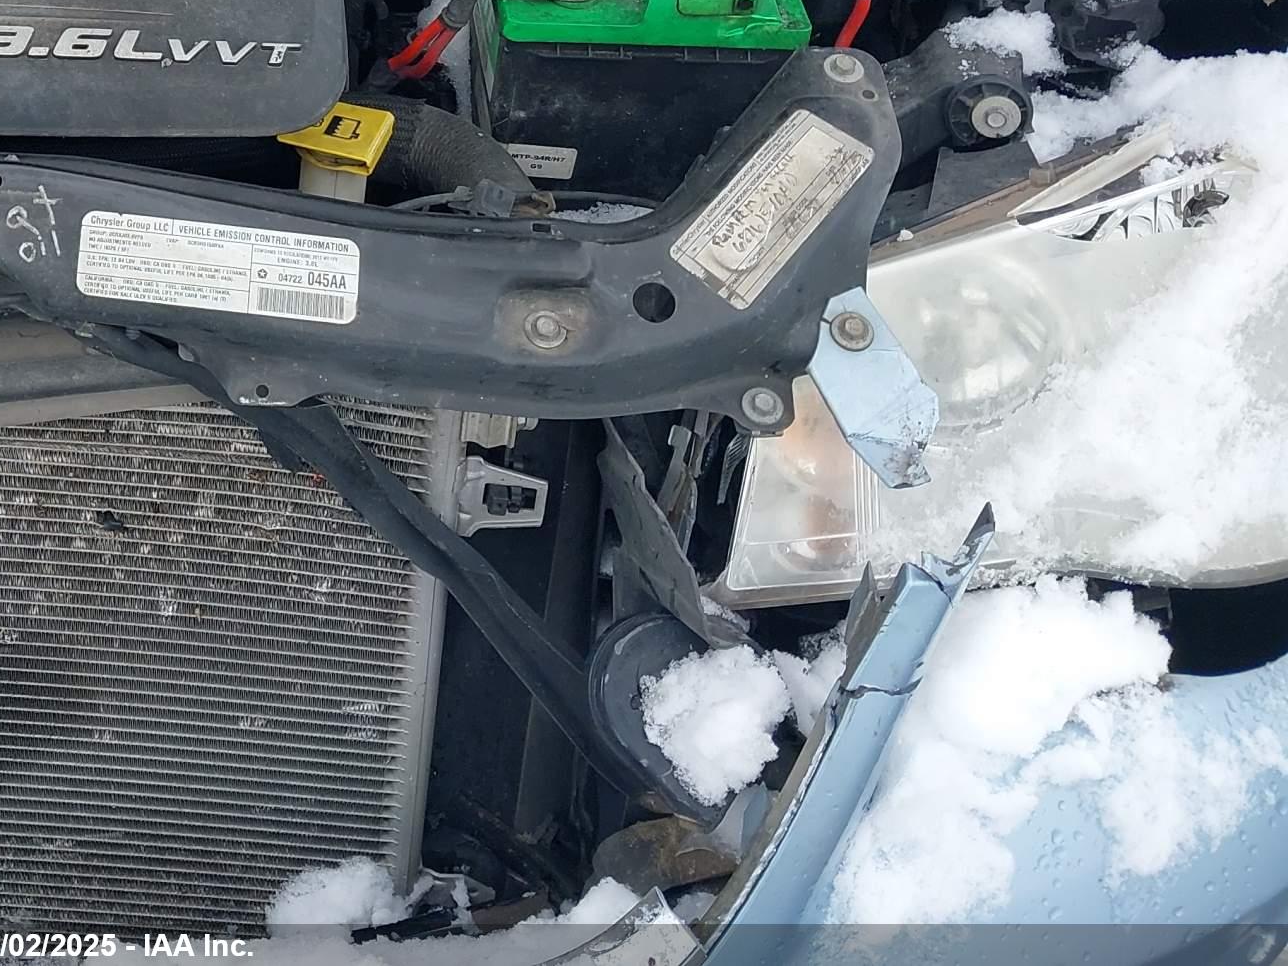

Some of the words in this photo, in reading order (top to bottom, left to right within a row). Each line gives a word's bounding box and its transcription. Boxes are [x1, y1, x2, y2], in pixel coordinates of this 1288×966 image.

[727, 161, 758, 195] MODIFICATIONS
[714, 203, 737, 228] FOLLOWING
[734, 172, 765, 205] MODIFICATIONS
[90, 215, 124, 228] Chrysler
[126, 219, 151, 231] Group
[154, 222, 169, 232] LLC
[178, 225, 211, 237] VEHICLE
[214, 229, 252, 241] EMISSION
[254, 234, 291, 246] CONTROL
[293, 238, 349, 252] INFORMATION
[278, 273, 303, 284] 04722
[307, 272, 348, 290] 045AA
